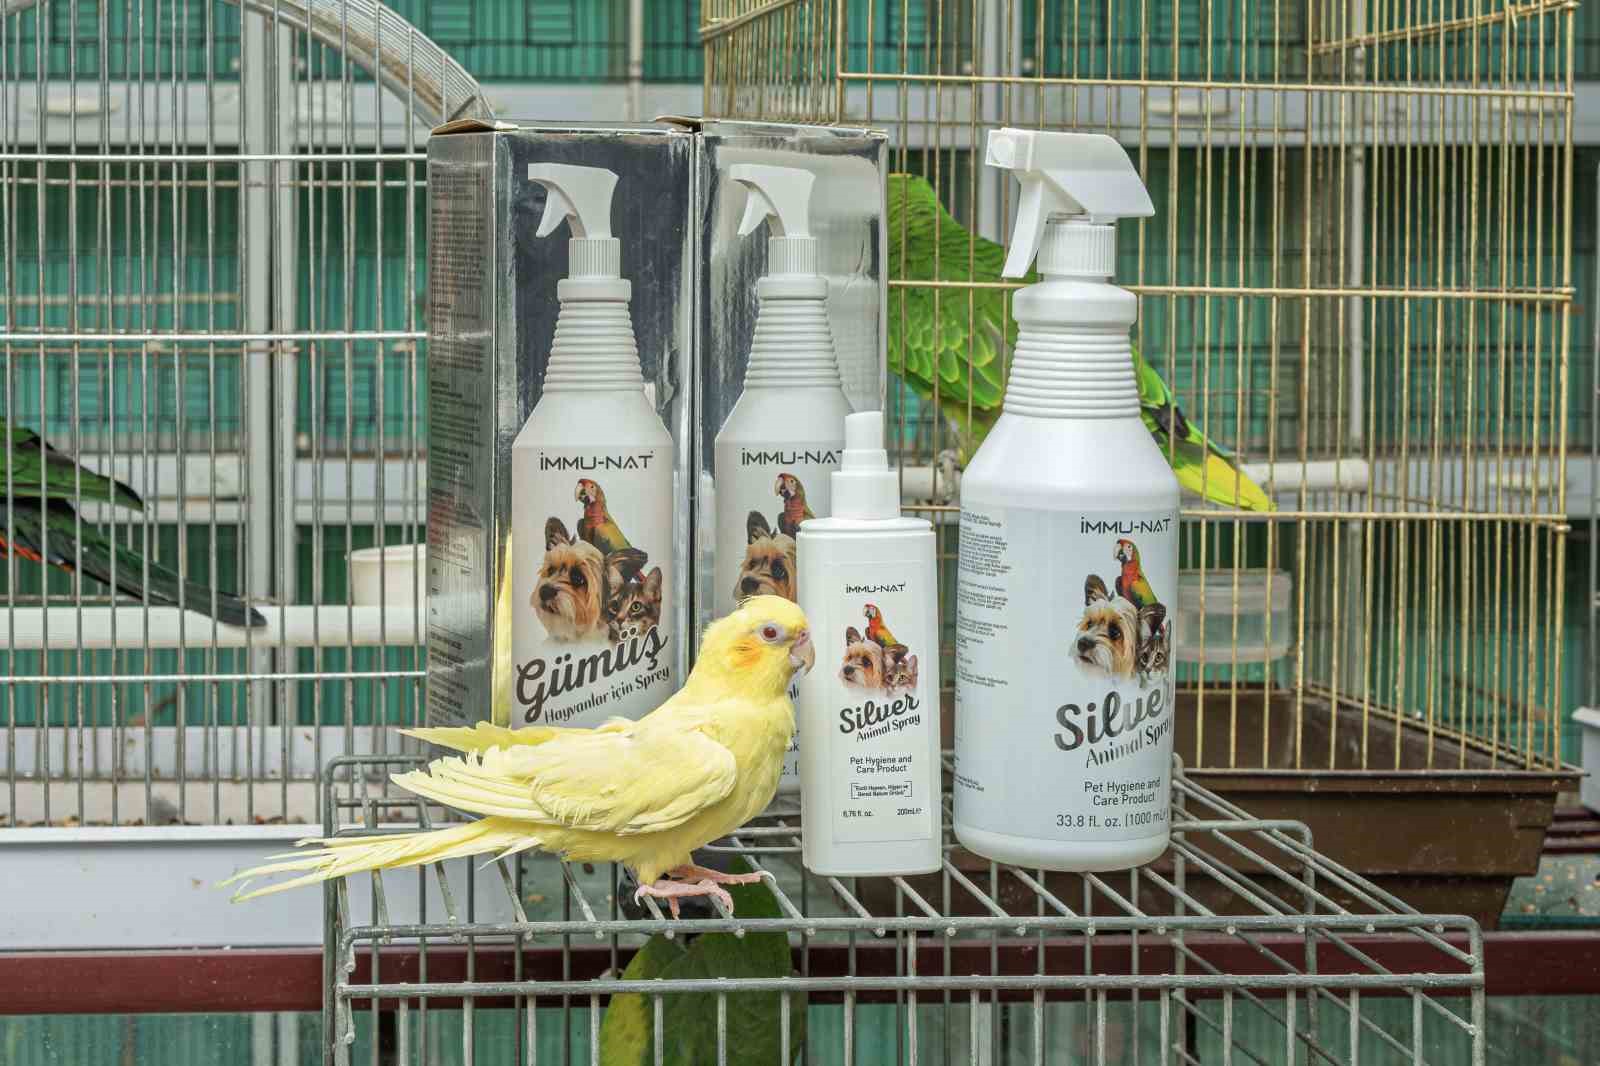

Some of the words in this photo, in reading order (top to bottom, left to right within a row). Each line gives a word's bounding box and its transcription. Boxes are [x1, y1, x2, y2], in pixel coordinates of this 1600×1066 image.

[516, 624, 668, 723] Gümüş
[544, 688, 609, 724] Hayvanlar
[611, 682, 633, 702] için
[635, 666, 670, 690] Sprey
[839, 693, 919, 733] Silver
[856, 722, 890, 742] Animal
[892, 712, 921, 732] Spray
[850, 757, 863, 765] Pet
[866, 756, 896, 766] Hygiene
[898, 755, 912, 764] and
[1086, 729, 1142, 768] Animal
[856, 765, 875, 773] Care
[877, 764, 907, 773] Product
[1084, 781, 1103, 793] Pet
[1107, 780, 1145, 795] Hygiene
[1147, 777, 1161, 789] and
[1093, 795, 1119, 806] Care
[1121, 792, 1155, 805] Product
[1056, 814, 1084, 827] 33.8
[1104, 817, 1121, 828] oz.
